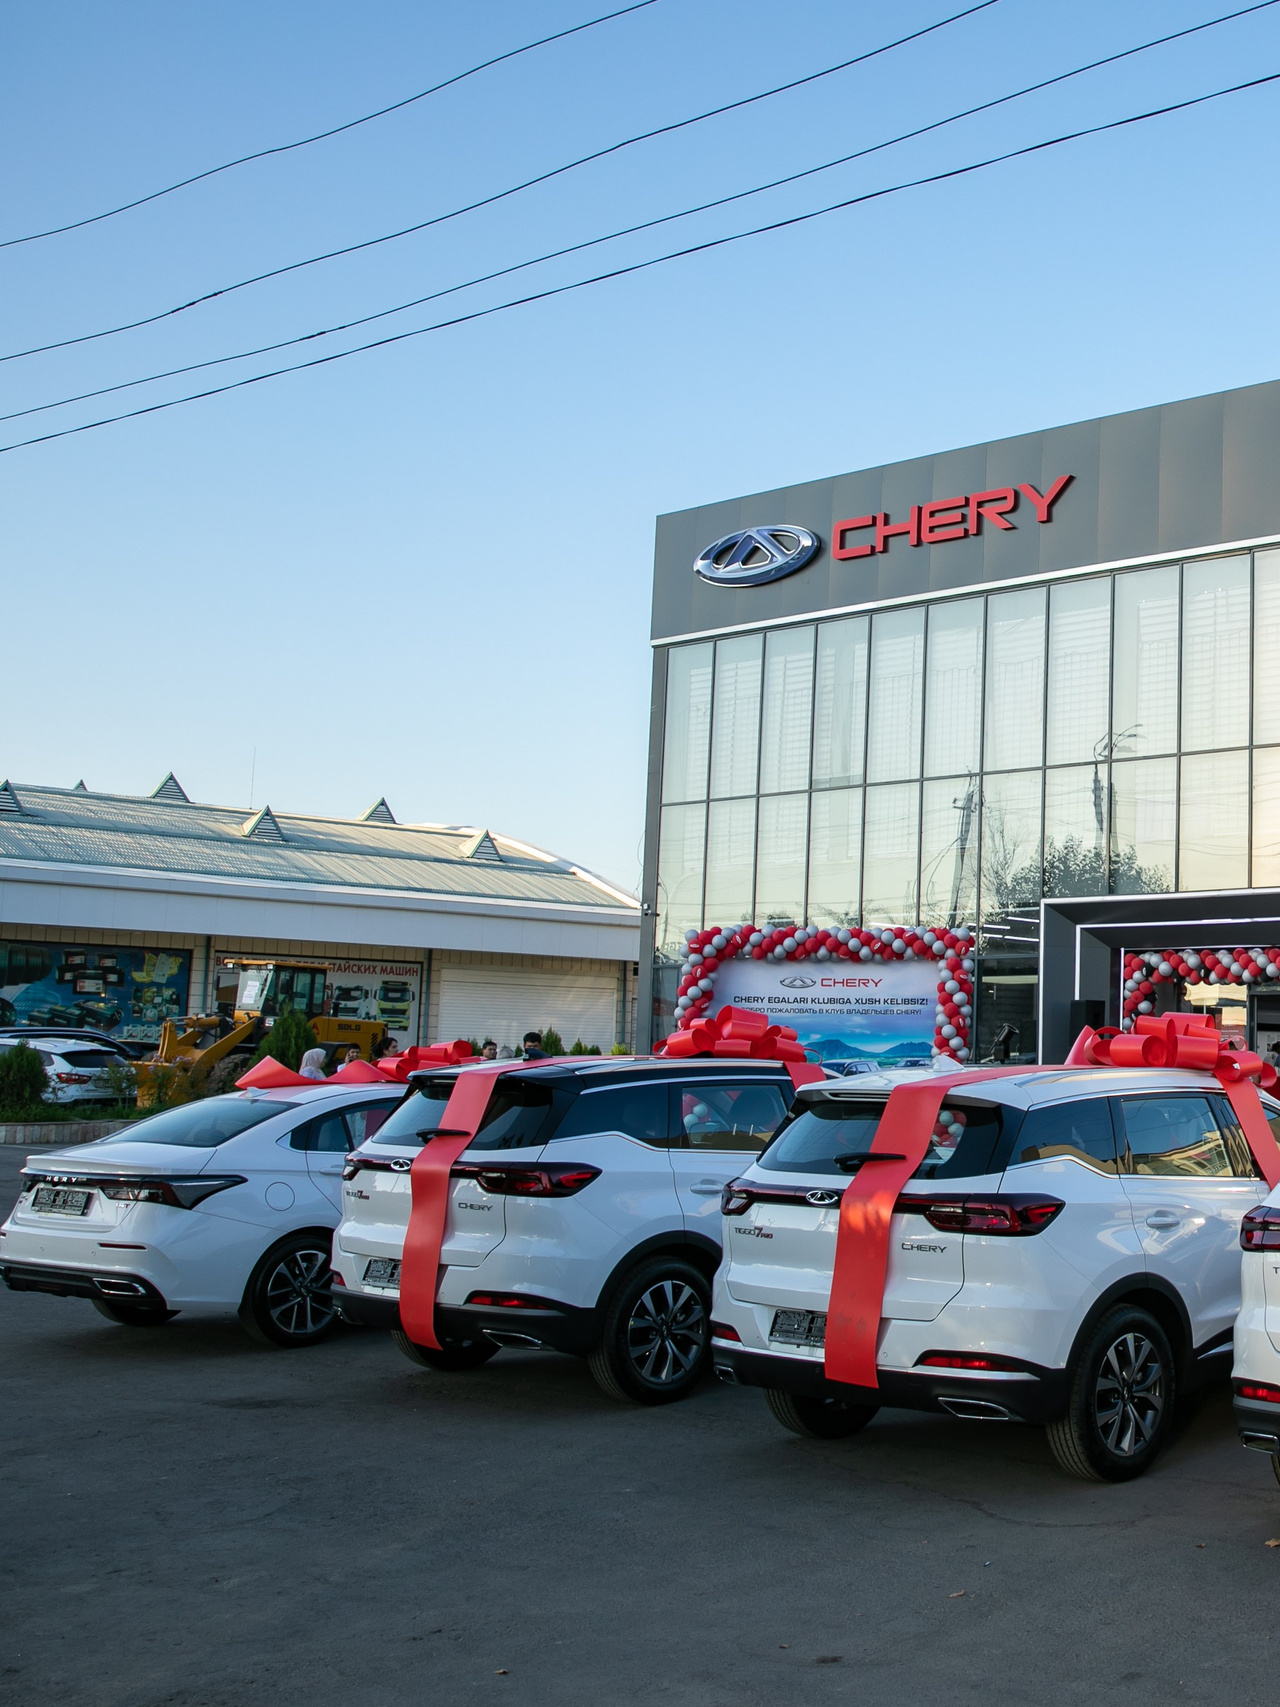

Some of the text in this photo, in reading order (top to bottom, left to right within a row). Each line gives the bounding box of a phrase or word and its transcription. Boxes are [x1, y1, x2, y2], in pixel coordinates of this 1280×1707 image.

[832, 474, 1076, 561] CHERY
[380, 965, 419, 977] МАШИН
[820, 977, 883, 988] CHERY
[733, 995, 929, 1006] CHERY EGALARI KLUBIGA XUSH KELIBSIZ!
[741, 1006, 766, 1014] ОБРО
[766, 1007, 818, 1015] ПОЖАЛОВАТЬ
[846, 1008, 895, 1016] ВЛАДЕЛЬЦЕВ
[458, 1202, 493, 1212] CHERY
[901, 1242, 948, 1254] CHERY
